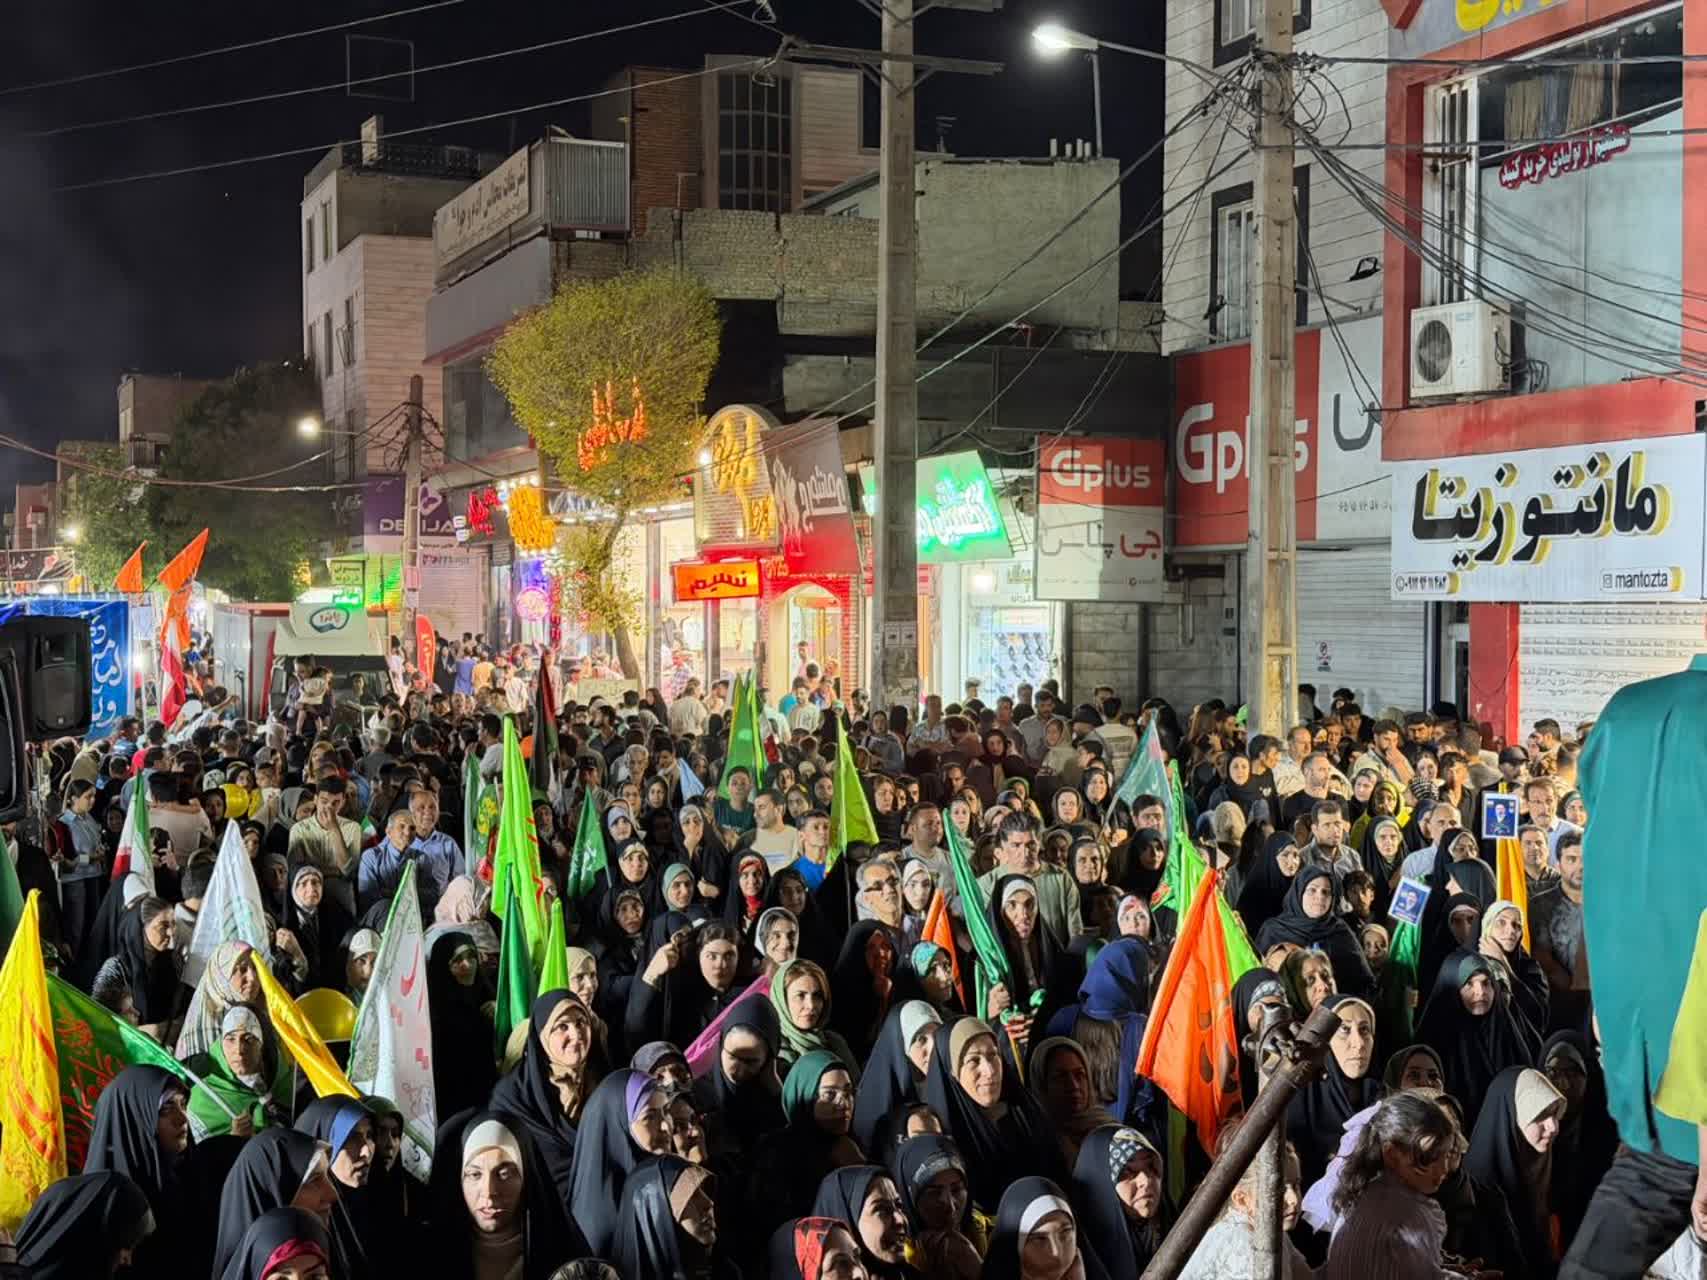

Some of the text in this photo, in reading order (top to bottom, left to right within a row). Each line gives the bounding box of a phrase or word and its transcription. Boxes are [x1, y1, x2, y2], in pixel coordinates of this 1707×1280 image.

[1176, 402, 1308, 494] Gpls
[1051, 449, 1151, 493] Gplus
[1411, 451, 1671, 572] مانتو زیتا
[1120, 529, 1162, 560] جی
[690, 571, 749, 597] نسیم
[1615, 571, 1669, 589] mantozta
